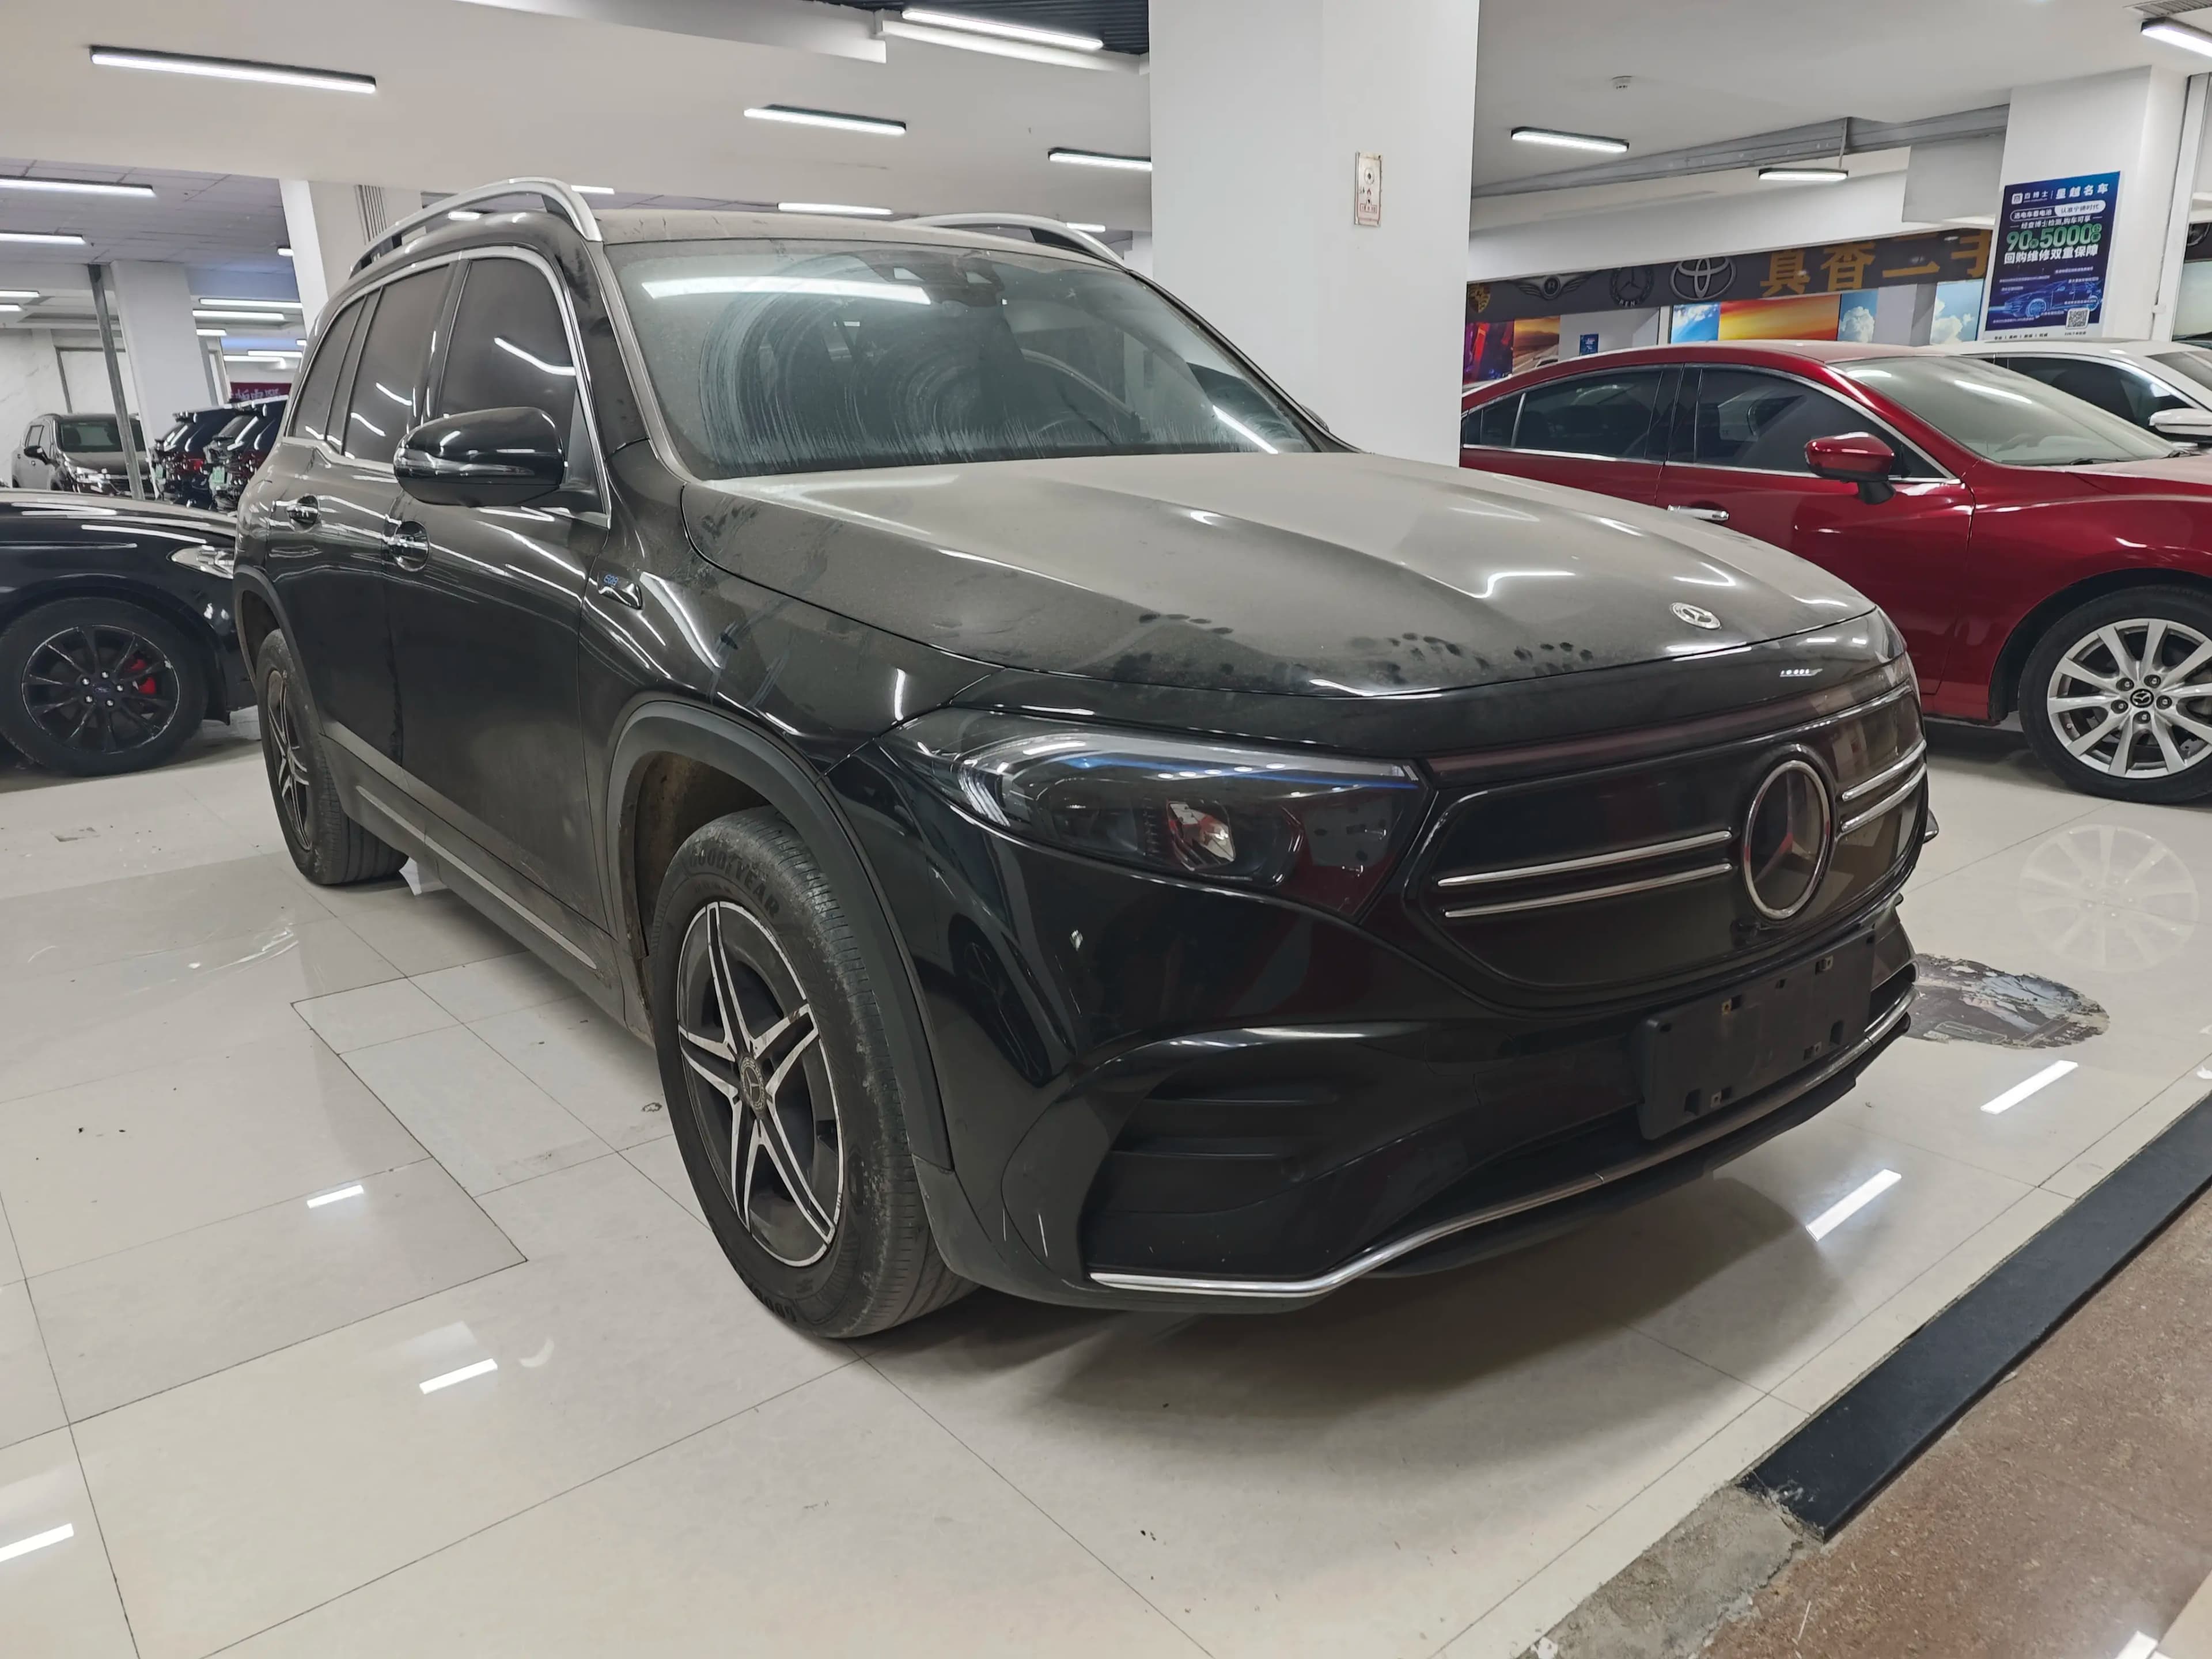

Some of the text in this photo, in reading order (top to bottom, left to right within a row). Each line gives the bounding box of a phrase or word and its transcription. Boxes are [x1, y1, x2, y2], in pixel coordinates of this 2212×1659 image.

[2004, 244, 2099, 265] 回购维修双重保障
